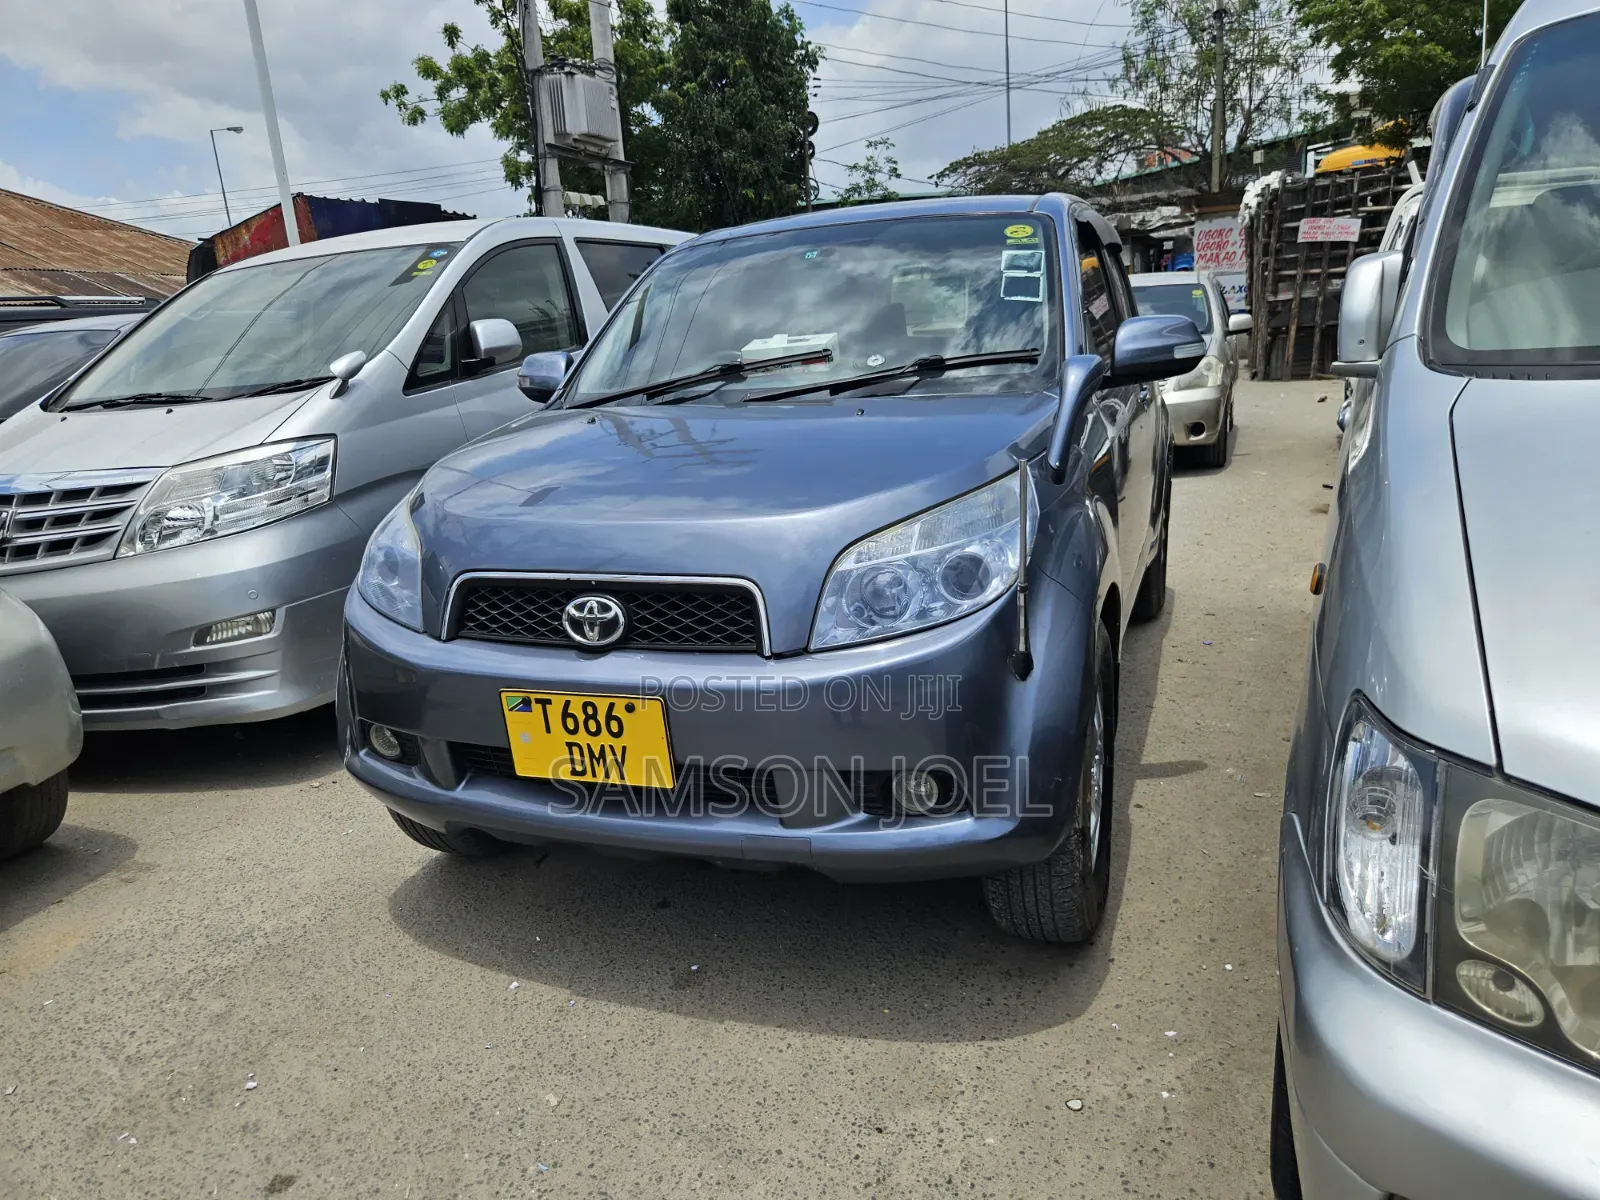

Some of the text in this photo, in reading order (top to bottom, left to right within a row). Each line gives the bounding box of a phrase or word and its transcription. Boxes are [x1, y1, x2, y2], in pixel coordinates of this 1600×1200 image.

[1197, 227, 1233, 241] UGORO
[1196, 240, 1229, 252] UGORO
[1196, 251, 1237, 264] MAKAO
[565, 741, 628, 781] DMY
